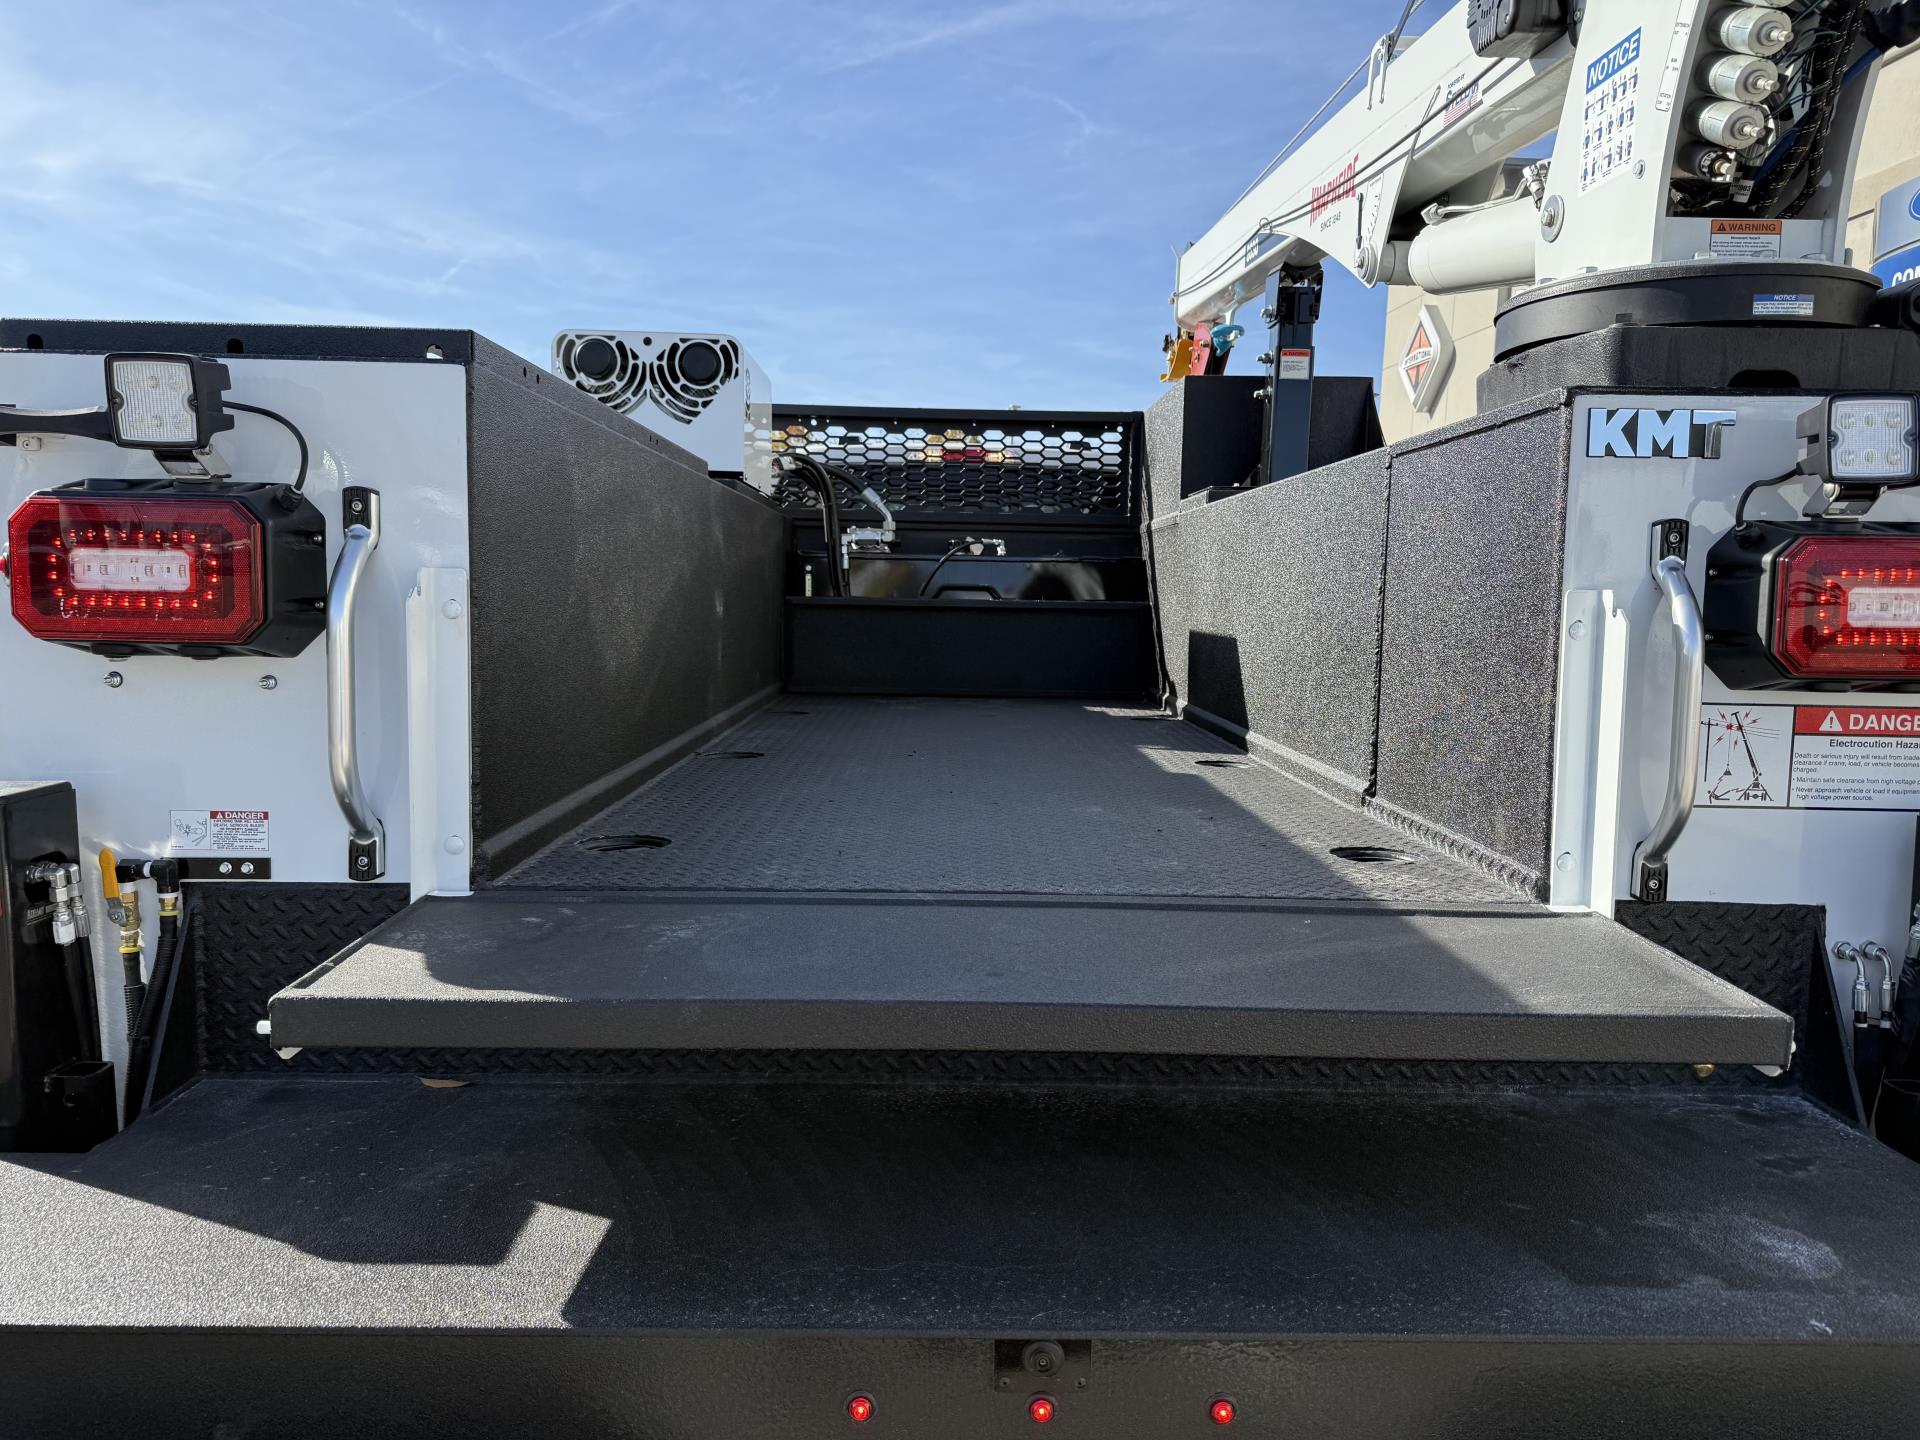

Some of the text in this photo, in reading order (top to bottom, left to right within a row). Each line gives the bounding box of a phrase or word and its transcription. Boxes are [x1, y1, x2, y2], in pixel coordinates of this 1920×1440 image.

[1588, 33, 1640, 88] NOTICE
[1310, 153, 1359, 227] KNAPHEIDE
[1728, 223, 1776, 232] WARNING
[1586, 407, 1737, 459] KMT
[1829, 739, 1893, 748] Electrocution
[1843, 753, 1859, 761] injury
[1848, 760, 1863, 768] load,
[1894, 778, 1916, 786] voltage
